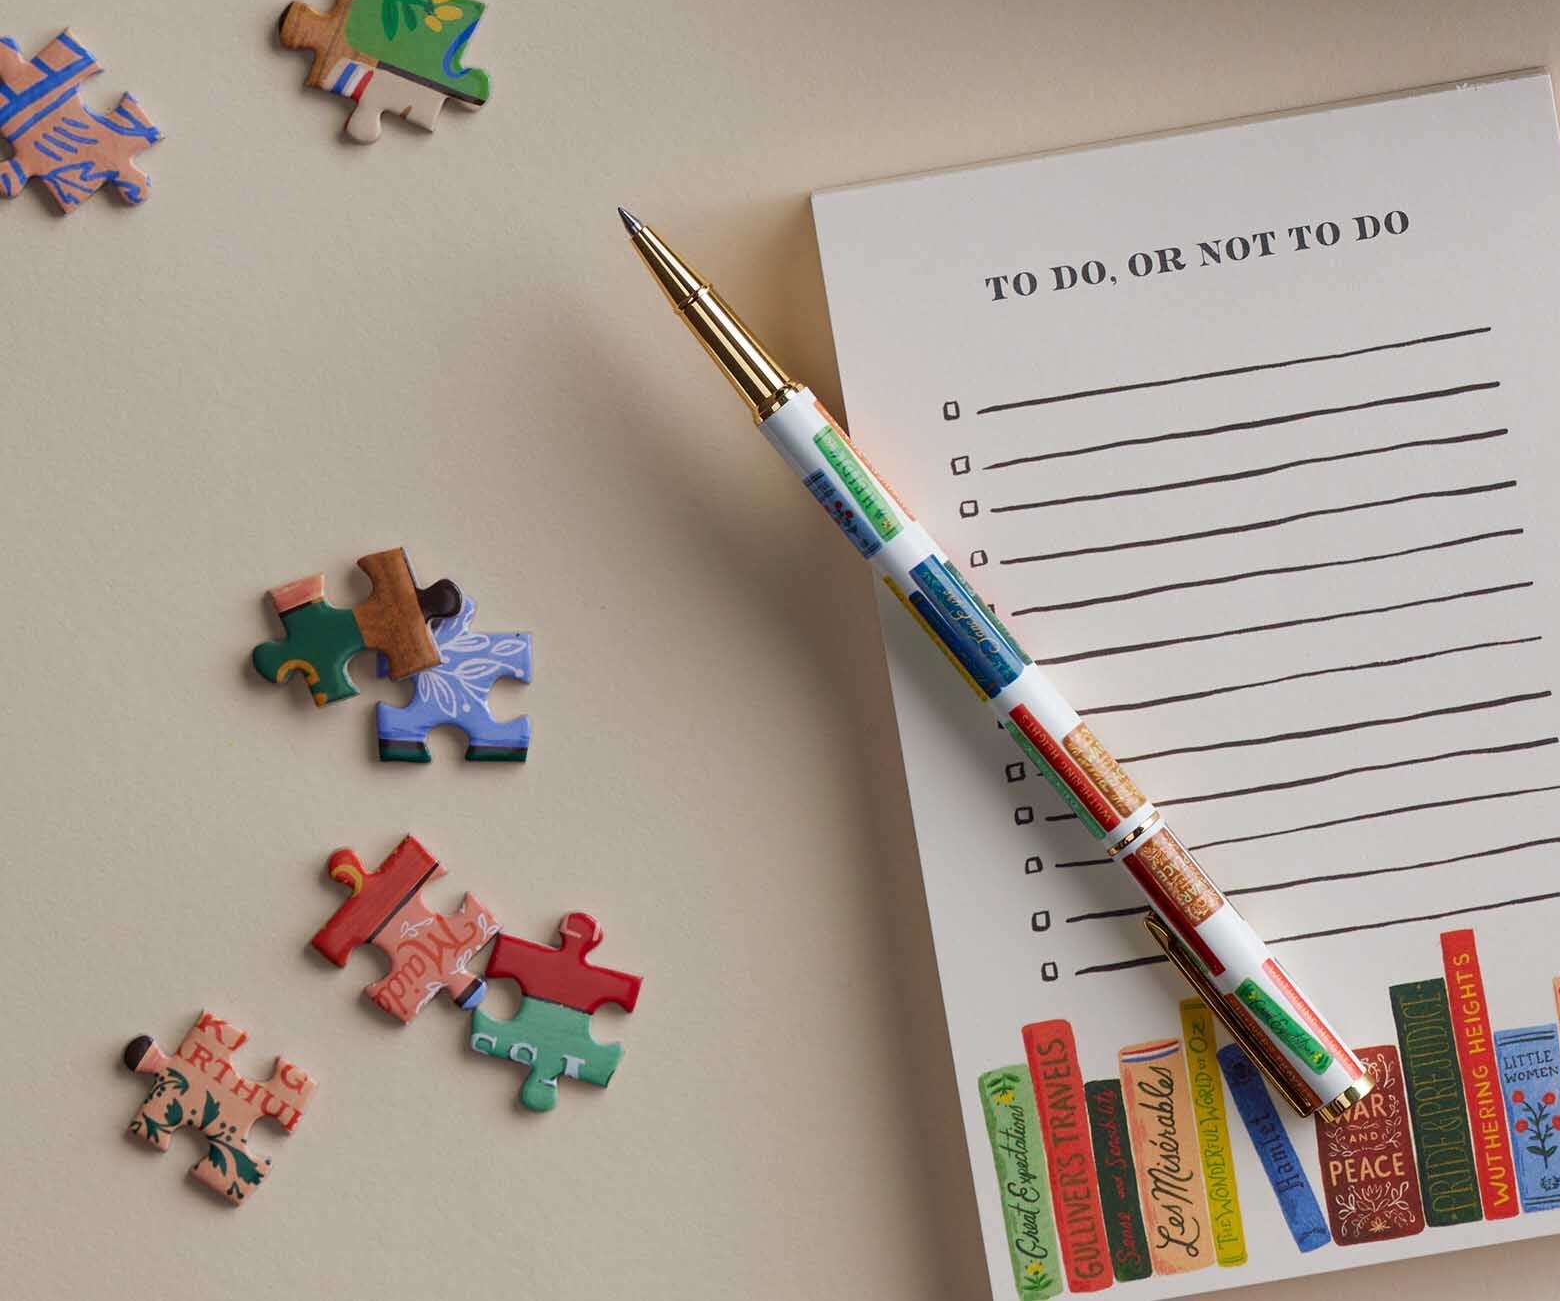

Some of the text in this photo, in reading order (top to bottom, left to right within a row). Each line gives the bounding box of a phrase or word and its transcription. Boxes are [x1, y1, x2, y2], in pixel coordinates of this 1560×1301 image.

[984, 210, 1410, 301] TO DO, OR NOT TO DO
[1021, 713, 1112, 823] WUTHERING HEIGHTS
[1453, 952, 1511, 1207] WUTHERING HEIGHTS
[1503, 1049, 1554, 1070] LITTLE
[1503, 1064, 1559, 1085] WOMEN
[1188, 1017, 1239, 1250] THE WONDERFUL WORLD OZ
[1252, 1112, 1306, 1196] Hamlet
[1333, 1093, 1386, 1124] WAR
[1349, 1131, 1379, 1144] AND
[1000, 1104, 1048, 1260] Great Expectations
[1036, 1037, 1104, 1280] GULLIVER'S TRAVELS
[1138, 1065, 1201, 1258] Les Misérables
[1329, 1152, 1405, 1187] PEACE
